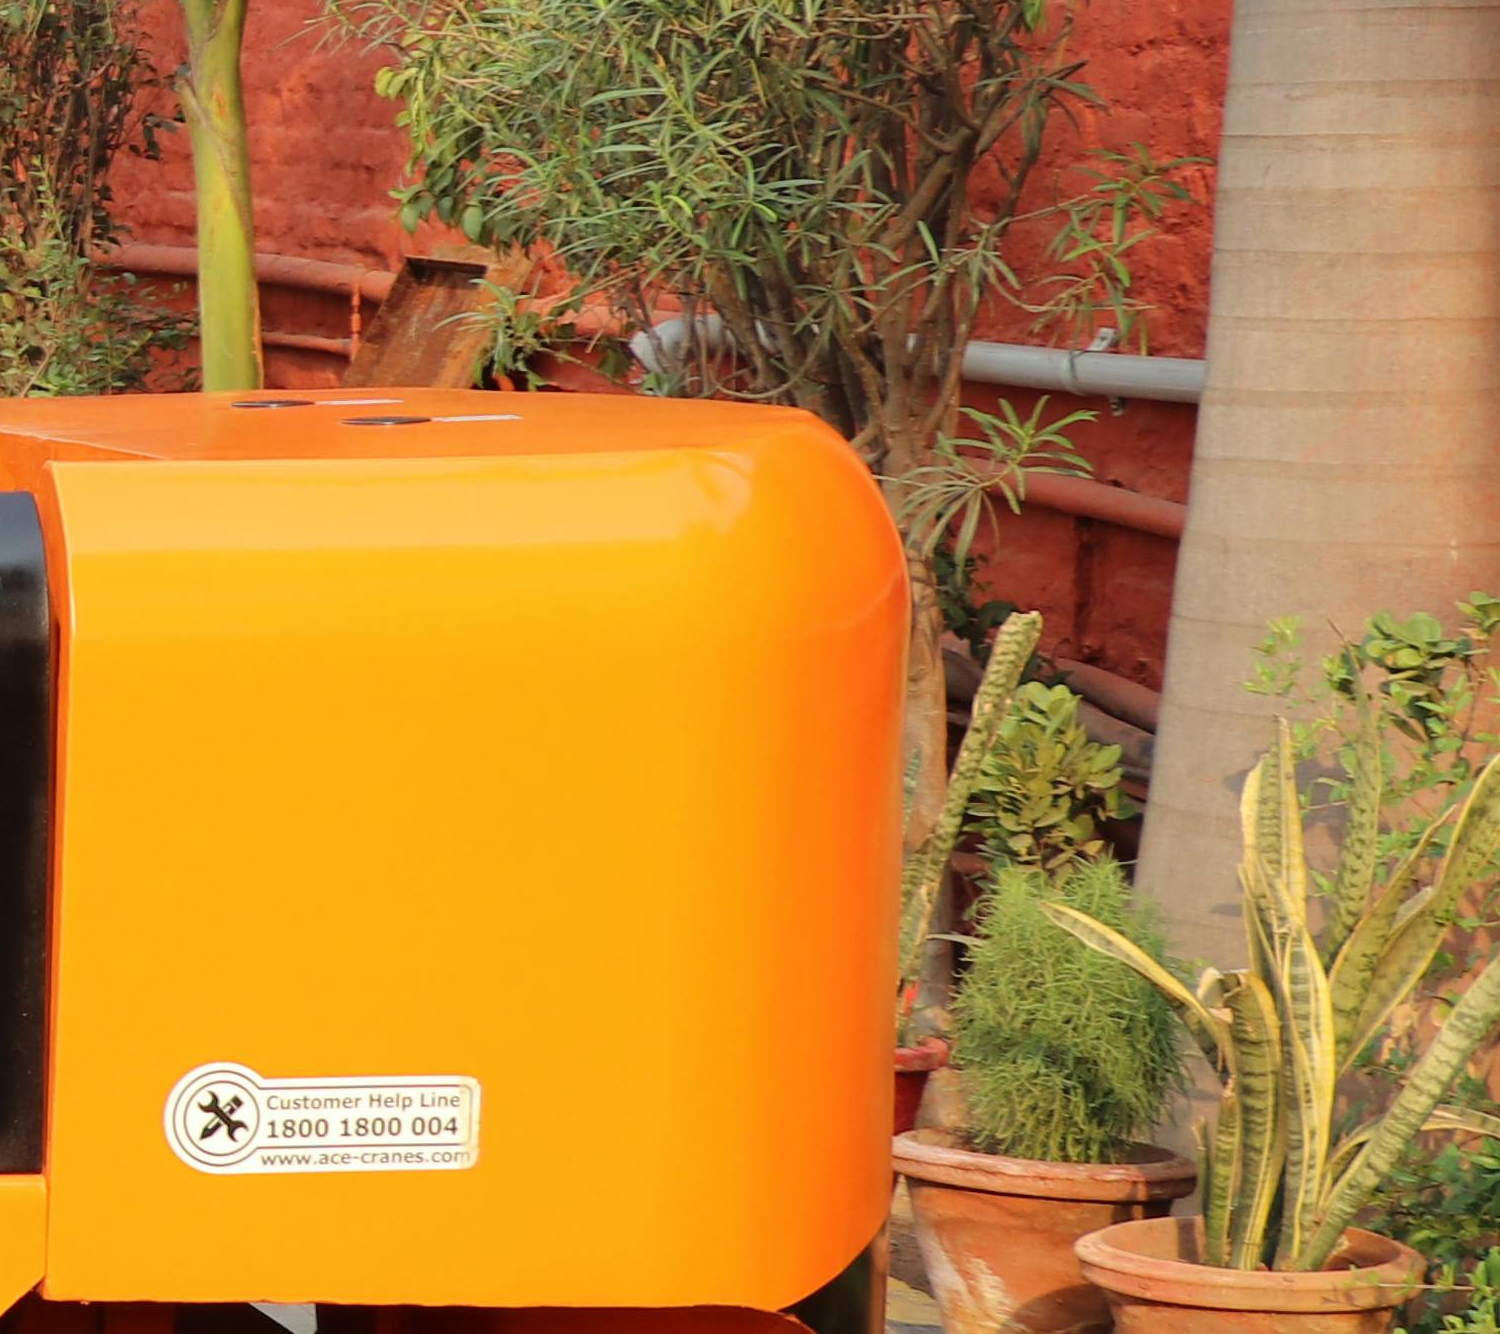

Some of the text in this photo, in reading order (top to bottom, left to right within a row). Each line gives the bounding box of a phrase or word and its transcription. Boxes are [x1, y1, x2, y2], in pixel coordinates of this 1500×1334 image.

[266, 1092, 461, 1112] Customer Help Line
[266, 1116, 459, 1139] 1800 1800 004
[261, 1149, 470, 1167] www.ace-cranes.com
